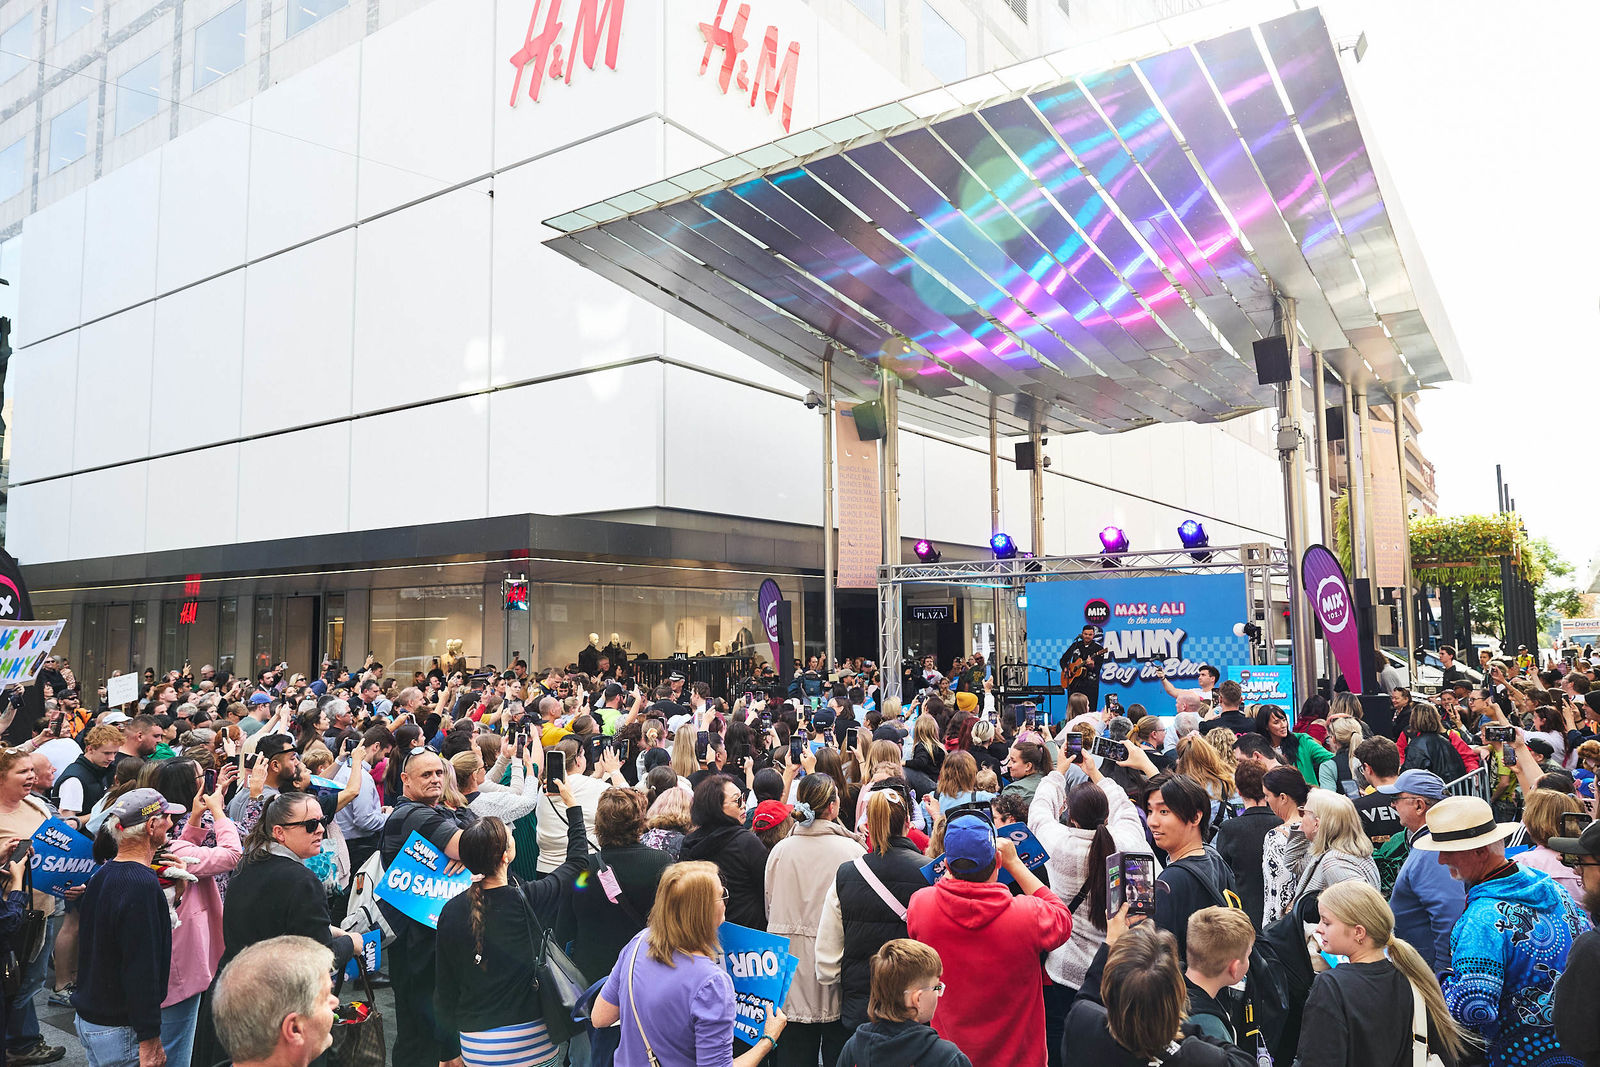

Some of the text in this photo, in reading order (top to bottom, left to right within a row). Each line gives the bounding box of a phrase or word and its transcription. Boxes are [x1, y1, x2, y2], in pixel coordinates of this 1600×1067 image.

[698, 0, 801, 134] H&M
[180, 602, 198, 624] H&M
[1088, 607, 1106, 616] MIX
[1115, 602, 1184, 616] MAX & ALI
[1322, 592, 1344, 614] MIX
[1136, 616, 1148, 624] the
[1096, 628, 1186, 660] AMMY
[1102, 662, 1137, 684] Boy
[46, 827, 73, 845] SAMMY
[413, 840, 439, 864] SAMMY
[42, 856, 96, 873] SAMMY
[388, 868, 412, 891] GO
[728, 950, 778, 978] OUR
[747, 994, 761, 1006] Boy
